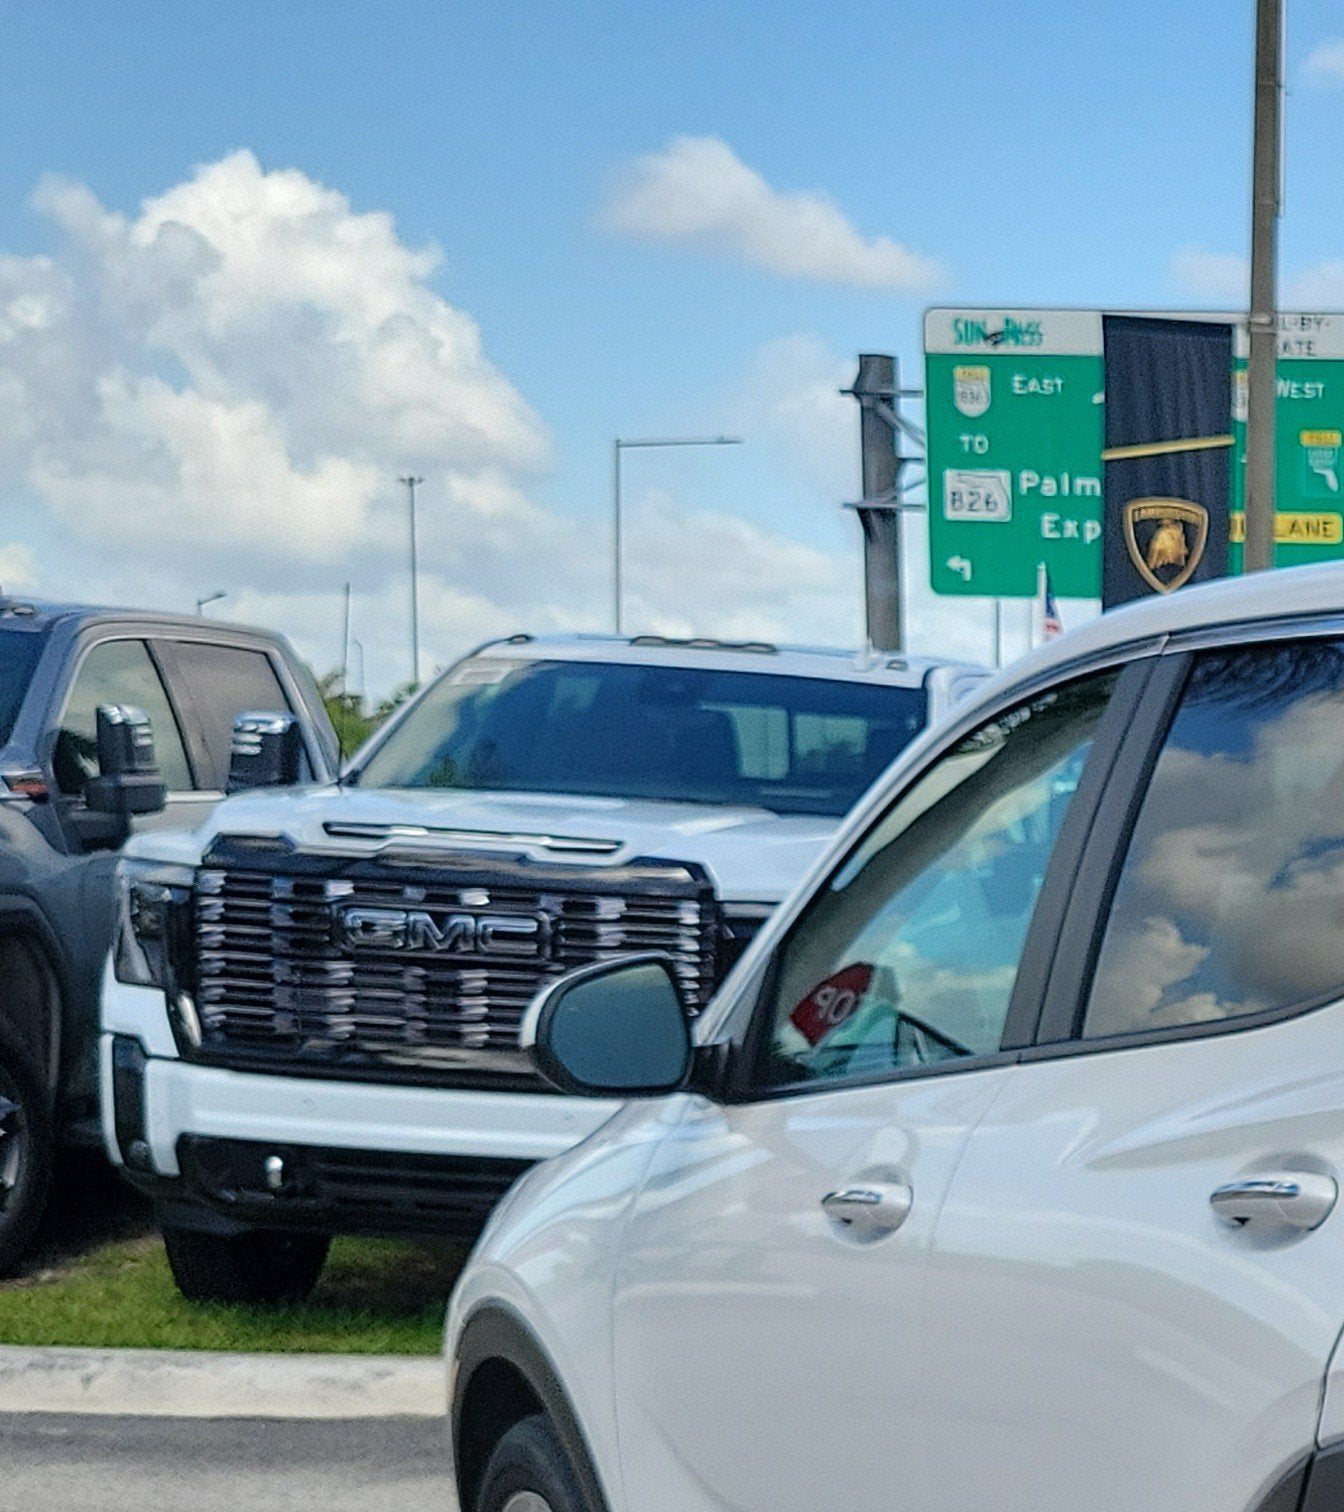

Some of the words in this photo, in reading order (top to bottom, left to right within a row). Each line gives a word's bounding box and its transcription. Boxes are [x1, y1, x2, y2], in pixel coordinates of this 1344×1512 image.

[1012, 374, 1064, 395] EAST
[1277, 379, 1325, 399] WEST
[959, 433, 989, 454] TO
[1019, 469, 1102, 497] Palm
[950, 490, 999, 512] 826
[1040, 512, 1102, 545] Exp
[345, 907, 539, 955] GMC
